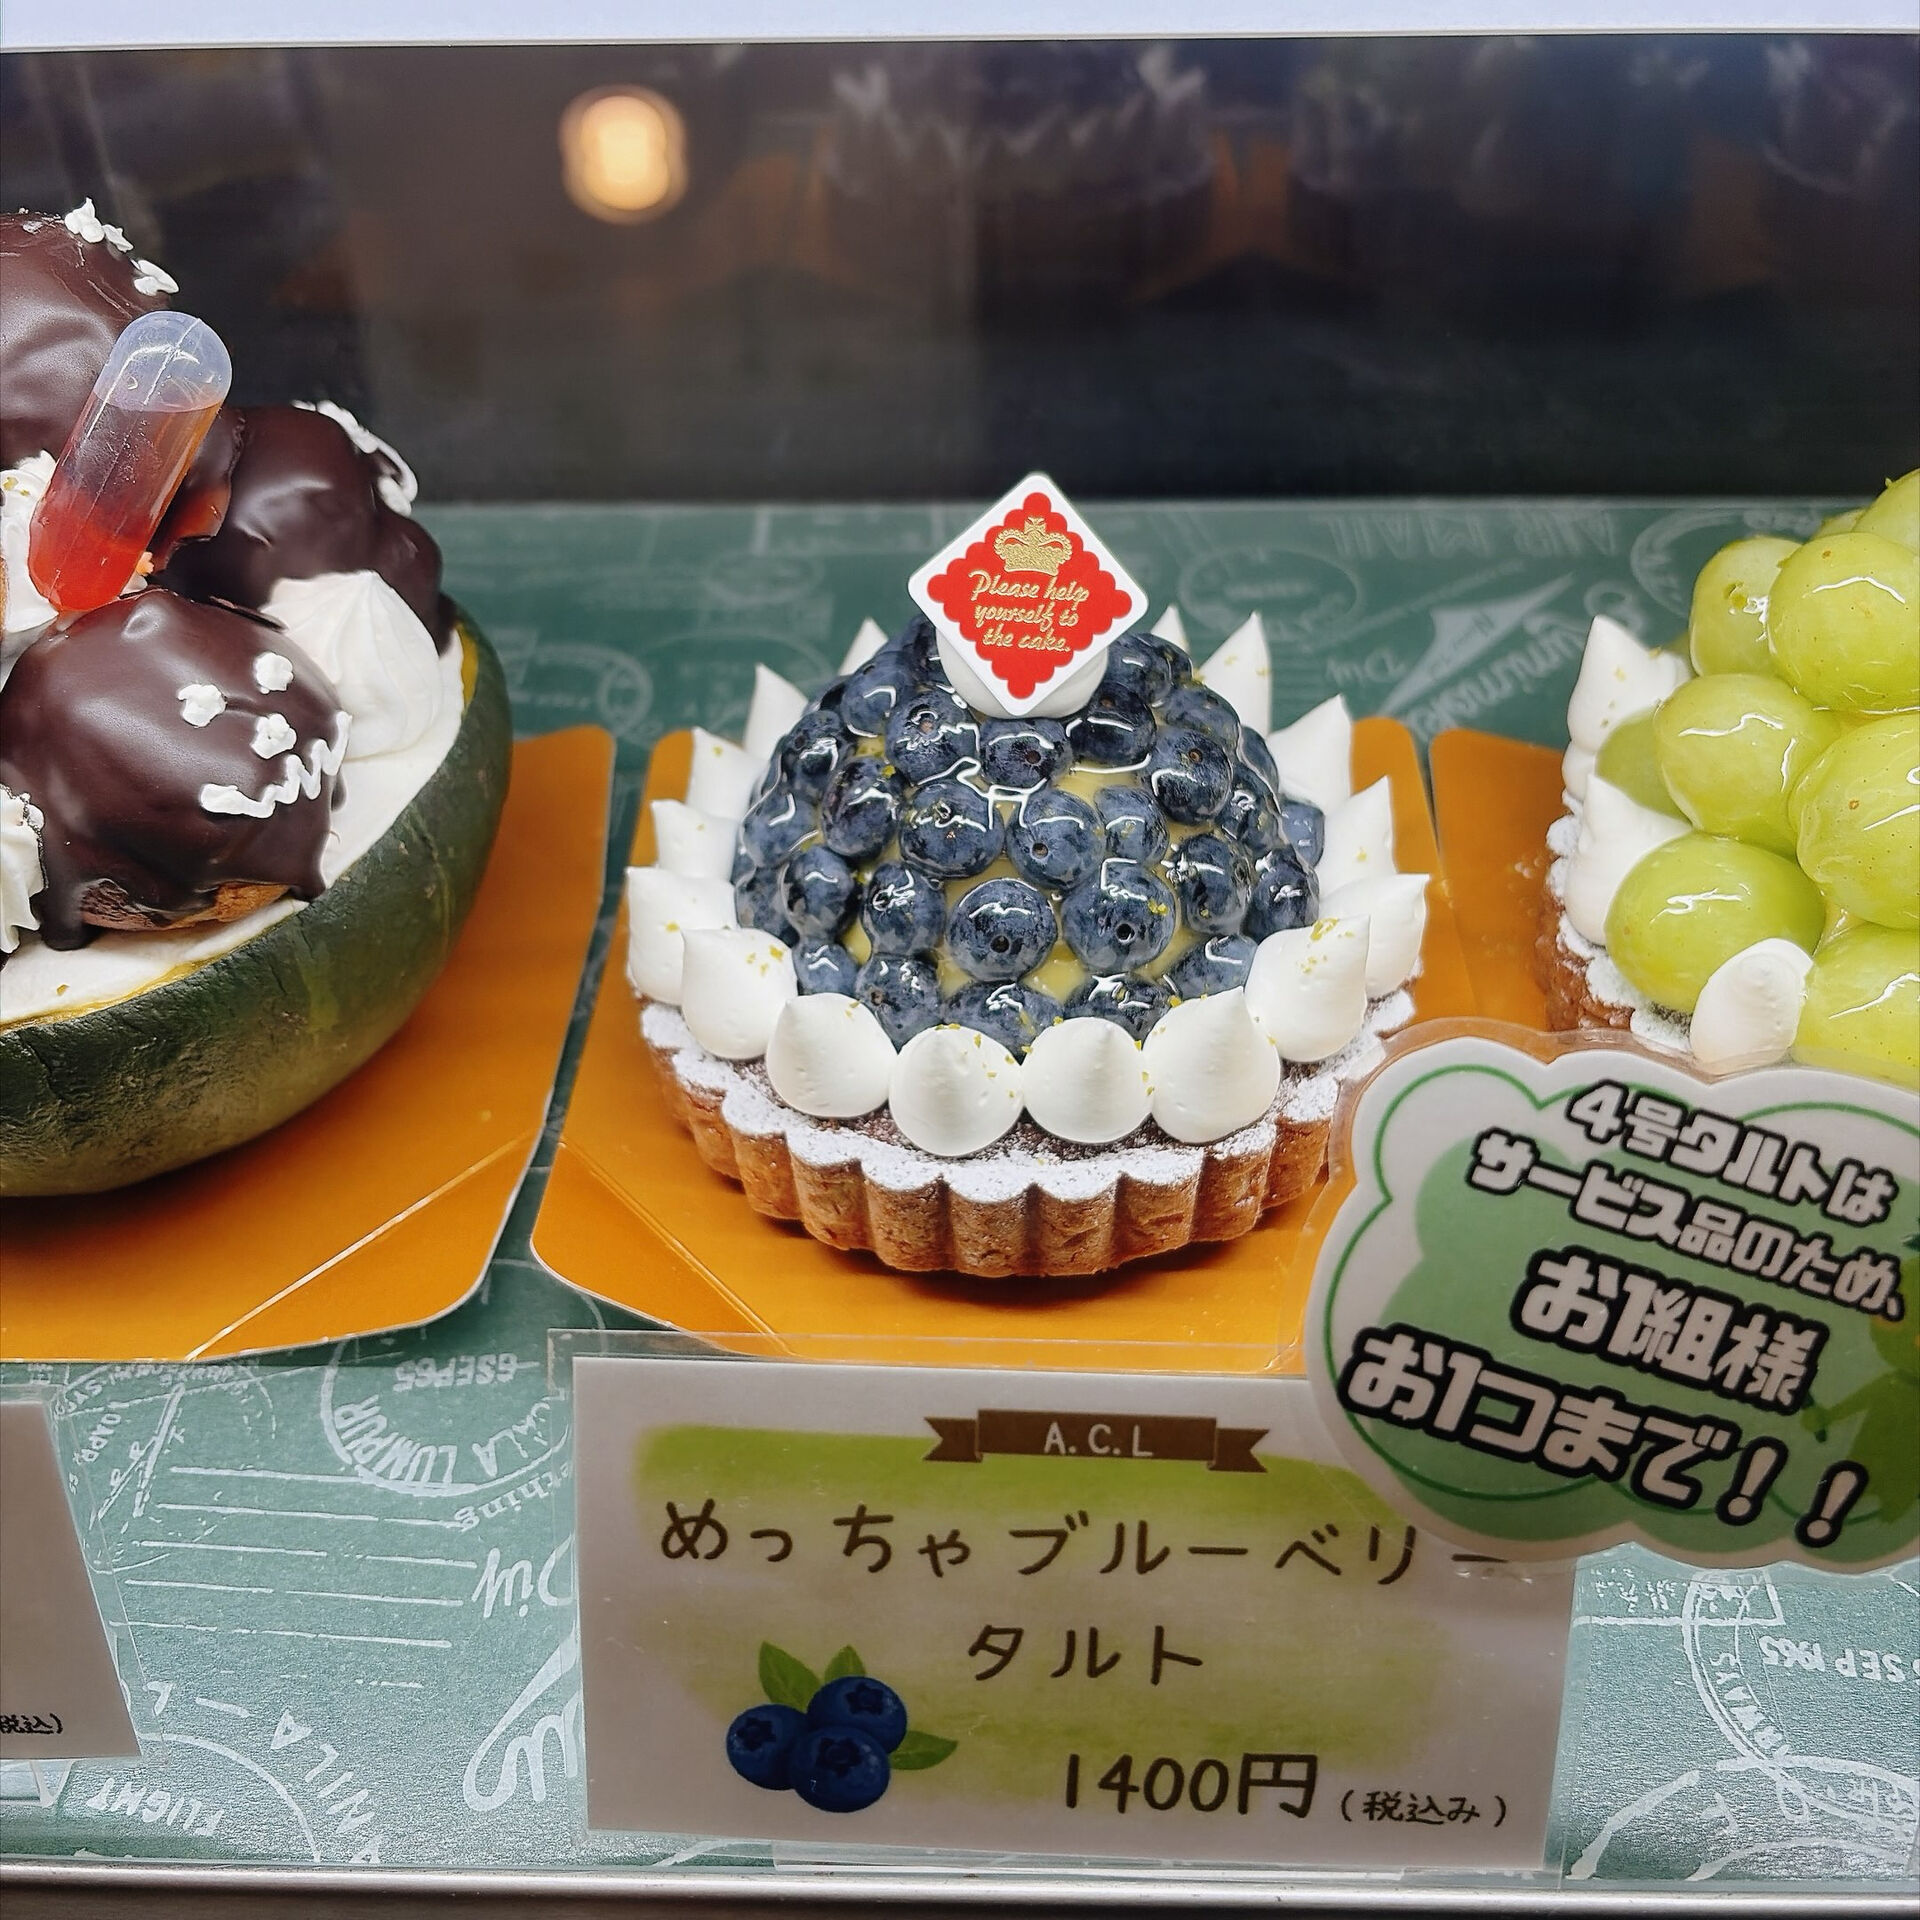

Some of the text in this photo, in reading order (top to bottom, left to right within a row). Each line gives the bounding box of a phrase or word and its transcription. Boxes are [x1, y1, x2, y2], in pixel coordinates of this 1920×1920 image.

[968, 569, 1090, 611] Please help
[974, 602, 1079, 631] yourself to
[982, 623, 1071, 652] the cake.
[1565, 1080, 1899, 1227] 4号タルトは
[1469, 1129, 1906, 1320] サービス品のため、
[1512, 1247, 1829, 1414] お1組様
[335, 1402, 457, 1486] LUMPUR
[965, 1625, 1204, 1686] タルト
[1063, 1753, 1508, 1828] 1400円 (税込み)
